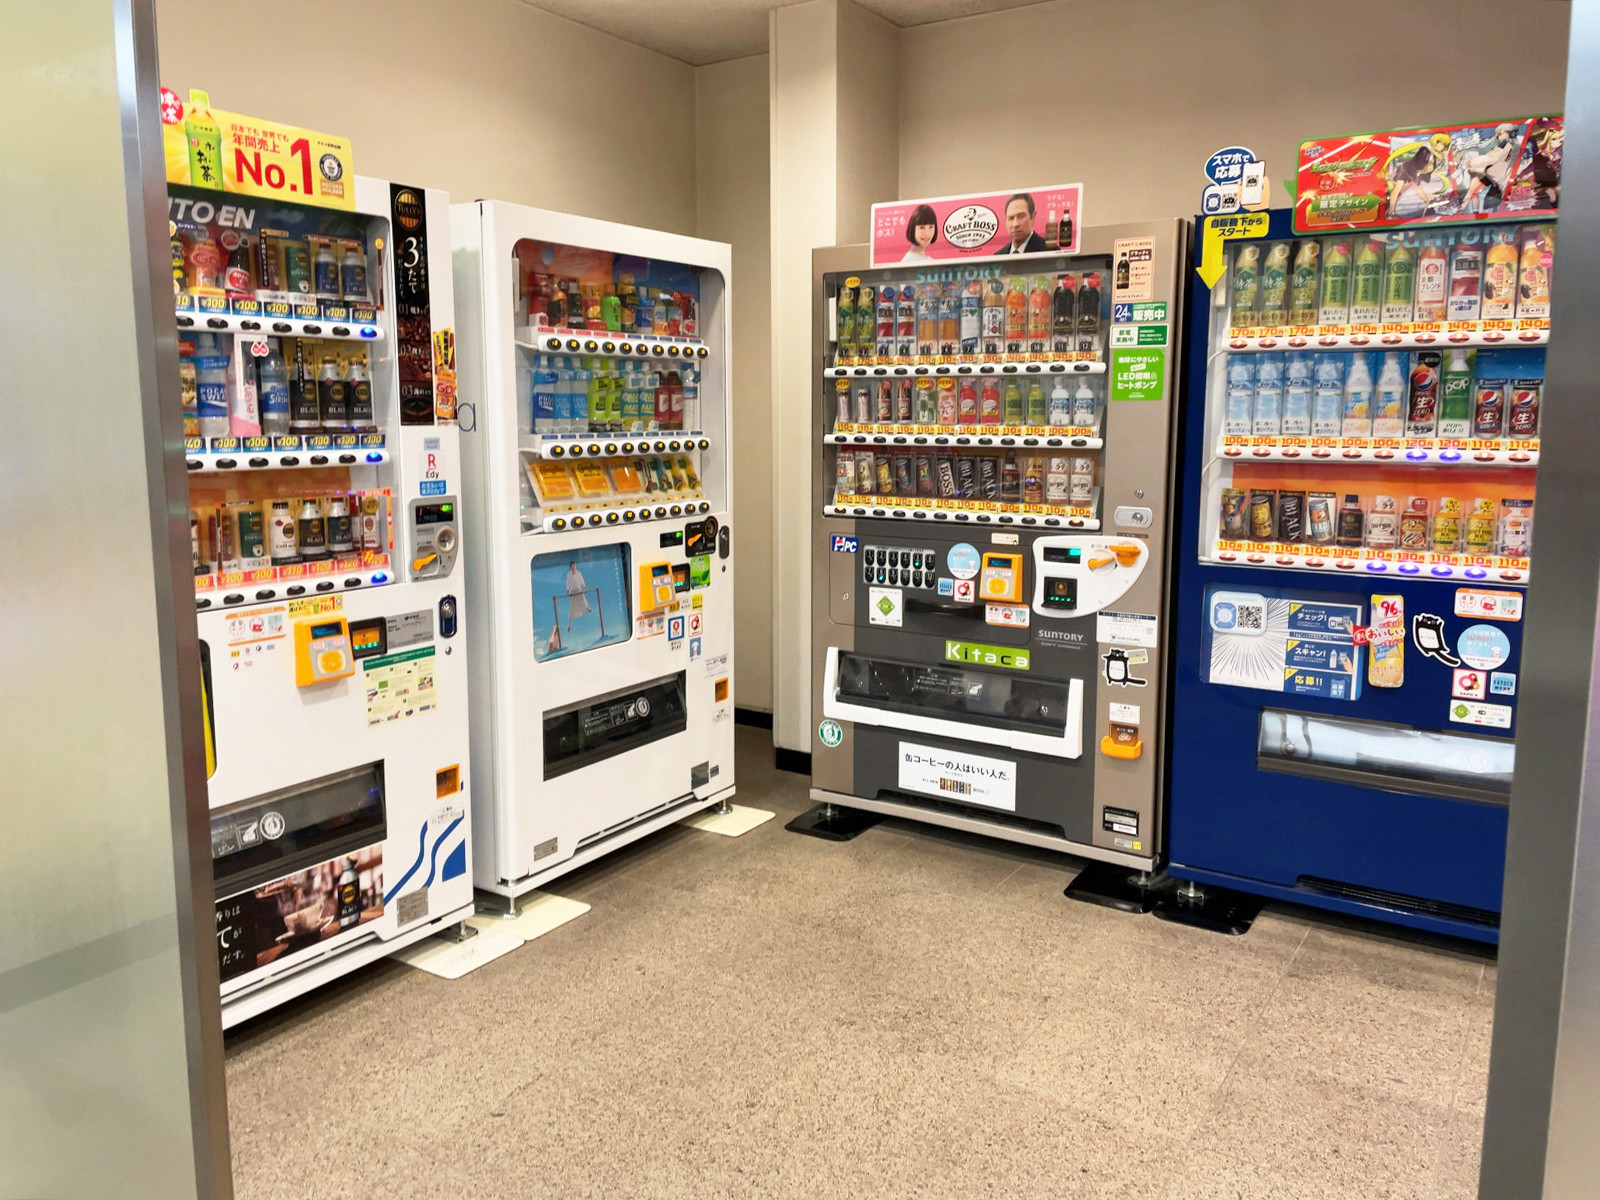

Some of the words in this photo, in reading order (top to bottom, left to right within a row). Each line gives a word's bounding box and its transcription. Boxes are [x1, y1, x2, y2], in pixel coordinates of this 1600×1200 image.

[231, 123, 259, 136] 日本でも
[233, 133, 281, 154] 年間売上
[1212, 152, 1251, 166] スマホで
[235, 139, 313, 195] No.1
[1214, 164, 1242, 179] 応募
[218, 205, 255, 230] EN
[878, 217, 906, 227] どこでも
[1210, 217, 1263, 228] 自販機下から
[945, 221, 971, 234] CRAFT
[973, 220, 996, 232] BOSS
[1218, 227, 1251, 237] スタート
[1385, 225, 1521, 249] SUNTORY
[403, 236, 419, 294] 3たて
[917, 266, 1002, 283] SUNTORY
[1236, 278, 1253, 289] 特茶
[1265, 277, 1284, 288] 特茶
[1294, 276, 1312, 288] 特茶
[202, 298, 225, 309] ¥100
[235, 300, 258, 311] ¥100
[268, 302, 288, 313] ¥100
[297, 305, 318, 315] ¥100
[1133, 309, 1165, 321] 販売中
[1319, 326, 1346, 334] 140円
[1350, 325, 1378, 333] 140円
[1413, 323, 1440, 331] 140円
[1448, 322, 1477, 330] 140円
[1483, 321, 1513, 329] 140円
[1520, 320, 1550, 328] 140円
[1117, 381, 1157, 390] ヒートポンプ
[1416, 396, 1427, 408] 生
[1482, 412, 1494, 424] 生
[1517, 412, 1529, 424] 生
[1049, 427, 1069, 435] 100円
[246, 437, 268, 447] ¥100
[278, 436, 298, 446] ¥100
[1282, 437, 1307, 445] 100円
[1311, 438, 1337, 446] 100円
[1342, 438, 1368, 446] 100円
[1373, 438, 1400, 447] 100円
[1406, 439, 1434, 447] 120円
[1439, 439, 1468, 447] 120円
[1473, 440, 1501, 448] 110円
[1509, 440, 1539, 449] 110円
[428, 453, 436, 467] R
[426, 470, 439, 479] Edy
[940, 465, 953, 497] BOSS
[960, 461, 974, 498] BLACK
[982, 461, 997, 499] BLACK
[1285, 499, 1301, 540] BLACK
[1219, 541, 1243, 549] 110円
[1246, 542, 1271, 551] 110円
[1276, 545, 1300, 553] 110円
[1305, 546, 1330, 554] 110円
[1333, 548, 1359, 557] 130円
[1366, 550, 1393, 559] 110円
[1398, 552, 1425, 561] 130円
[1431, 554, 1459, 563] 110円
[1465, 556, 1493, 565] 110円
[1499, 559, 1528, 568] 110円
[1297, 613, 1327, 622] チェック!
[1038, 629, 1084, 642] SUNTORY
[1367, 629, 1404, 639] おいしい
[947, 642, 1029, 668] Kitaca
[1295, 647, 1326, 657] スキャン!
[1294, 675, 1323, 686] 応募!!
[905, 753, 1010, 781] 缶コーヒーの人はいい人だ。
